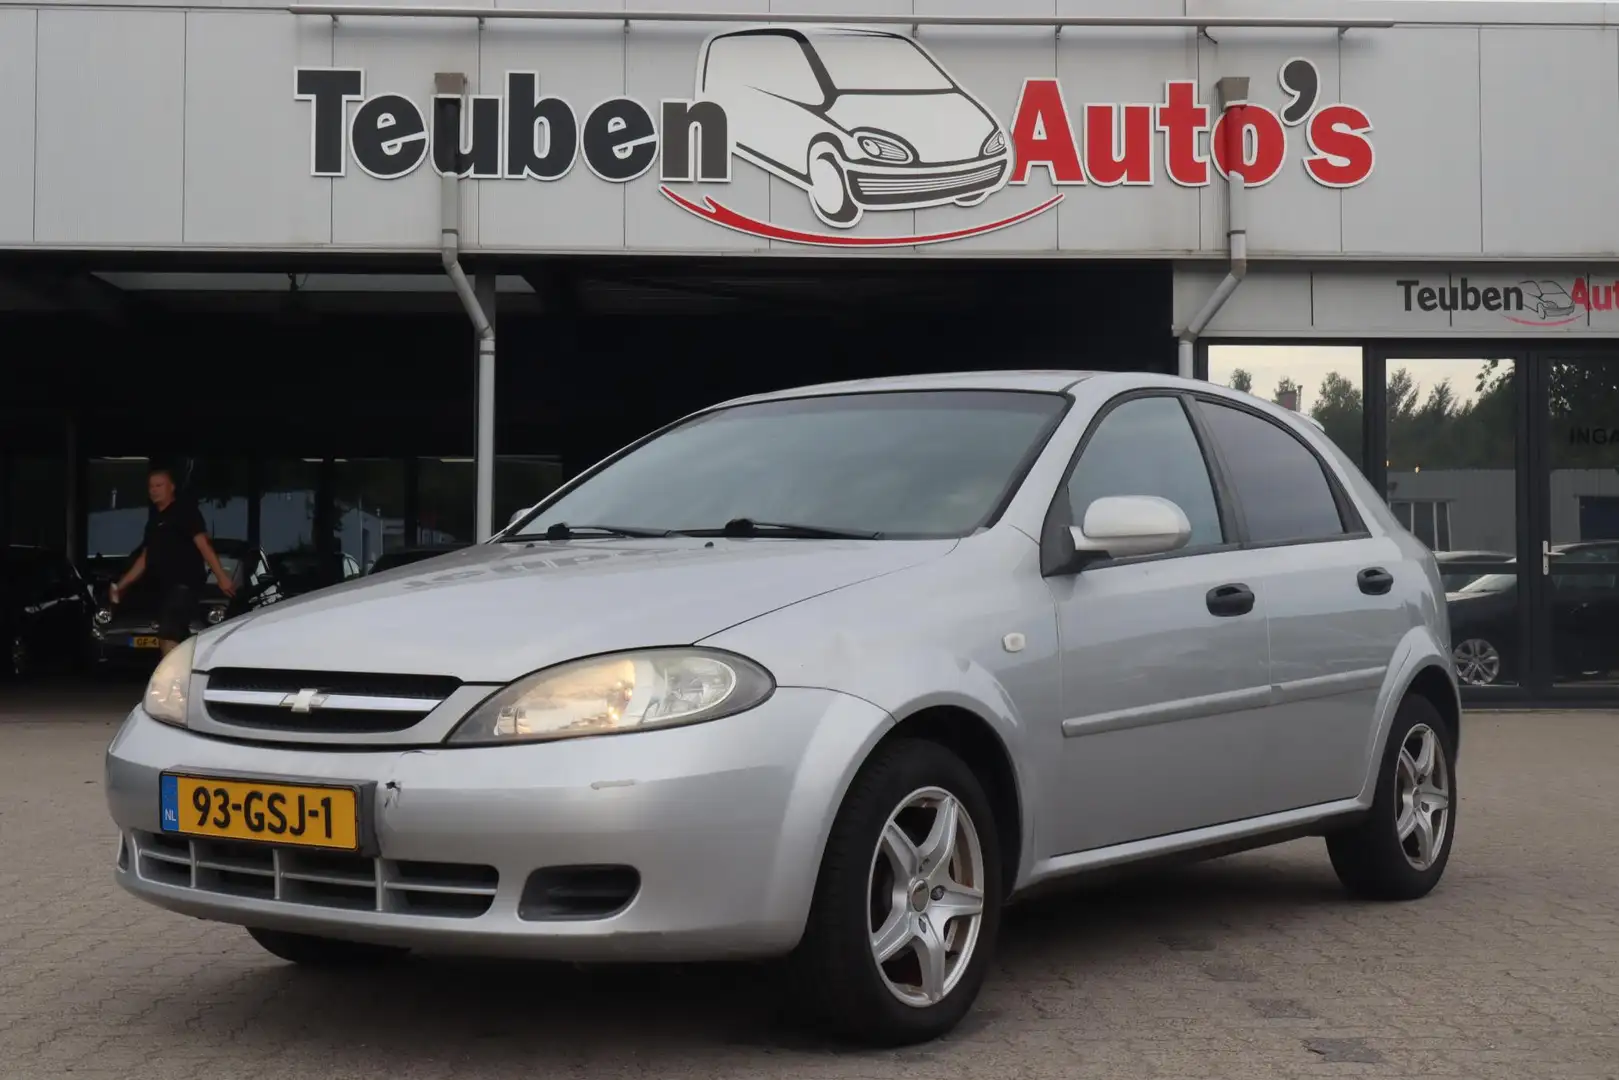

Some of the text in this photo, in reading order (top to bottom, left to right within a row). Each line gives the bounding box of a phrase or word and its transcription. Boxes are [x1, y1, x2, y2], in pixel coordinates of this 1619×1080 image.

[295, 56, 1376, 189] Teuben Auto's
[1396, 277, 1524, 311] Teuben
[164, 808, 177, 822] NL
[192, 785, 333, 840] 93-GSJ-1
